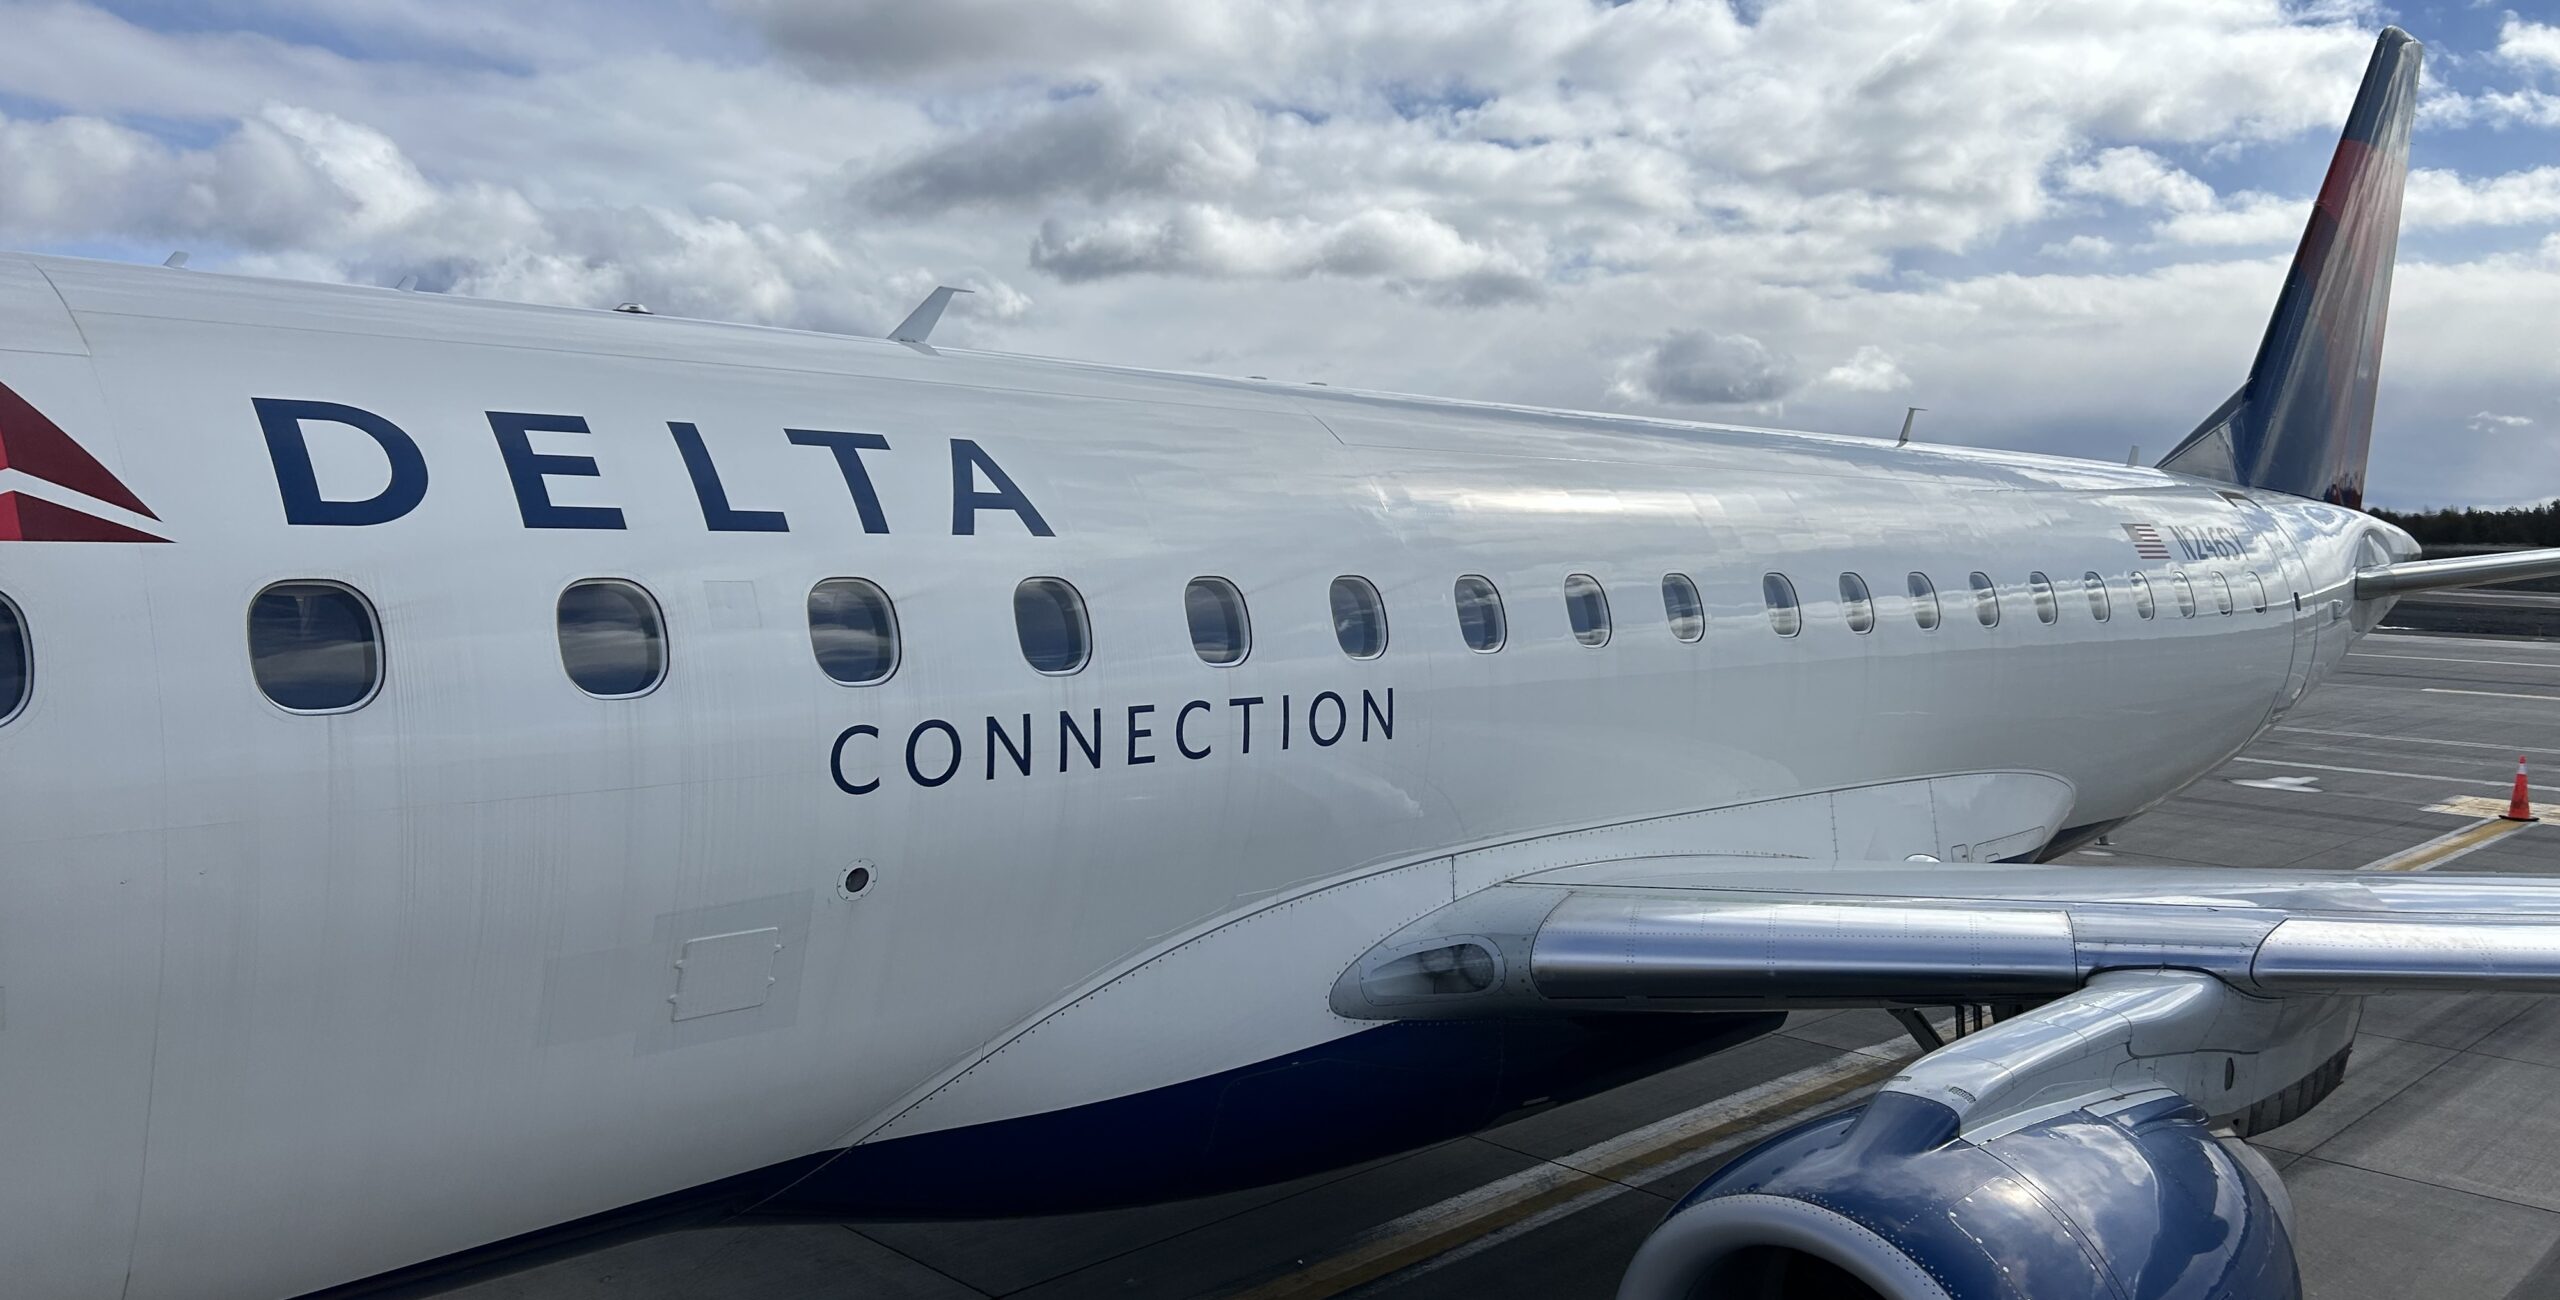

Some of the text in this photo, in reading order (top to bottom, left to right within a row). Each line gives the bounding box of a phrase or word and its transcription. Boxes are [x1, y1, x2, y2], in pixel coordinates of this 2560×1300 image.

[250, 397, 1056, 537] DELTA
[2168, 525, 2249, 560] N246SY
[830, 688, 1394, 795] CONNECTION
